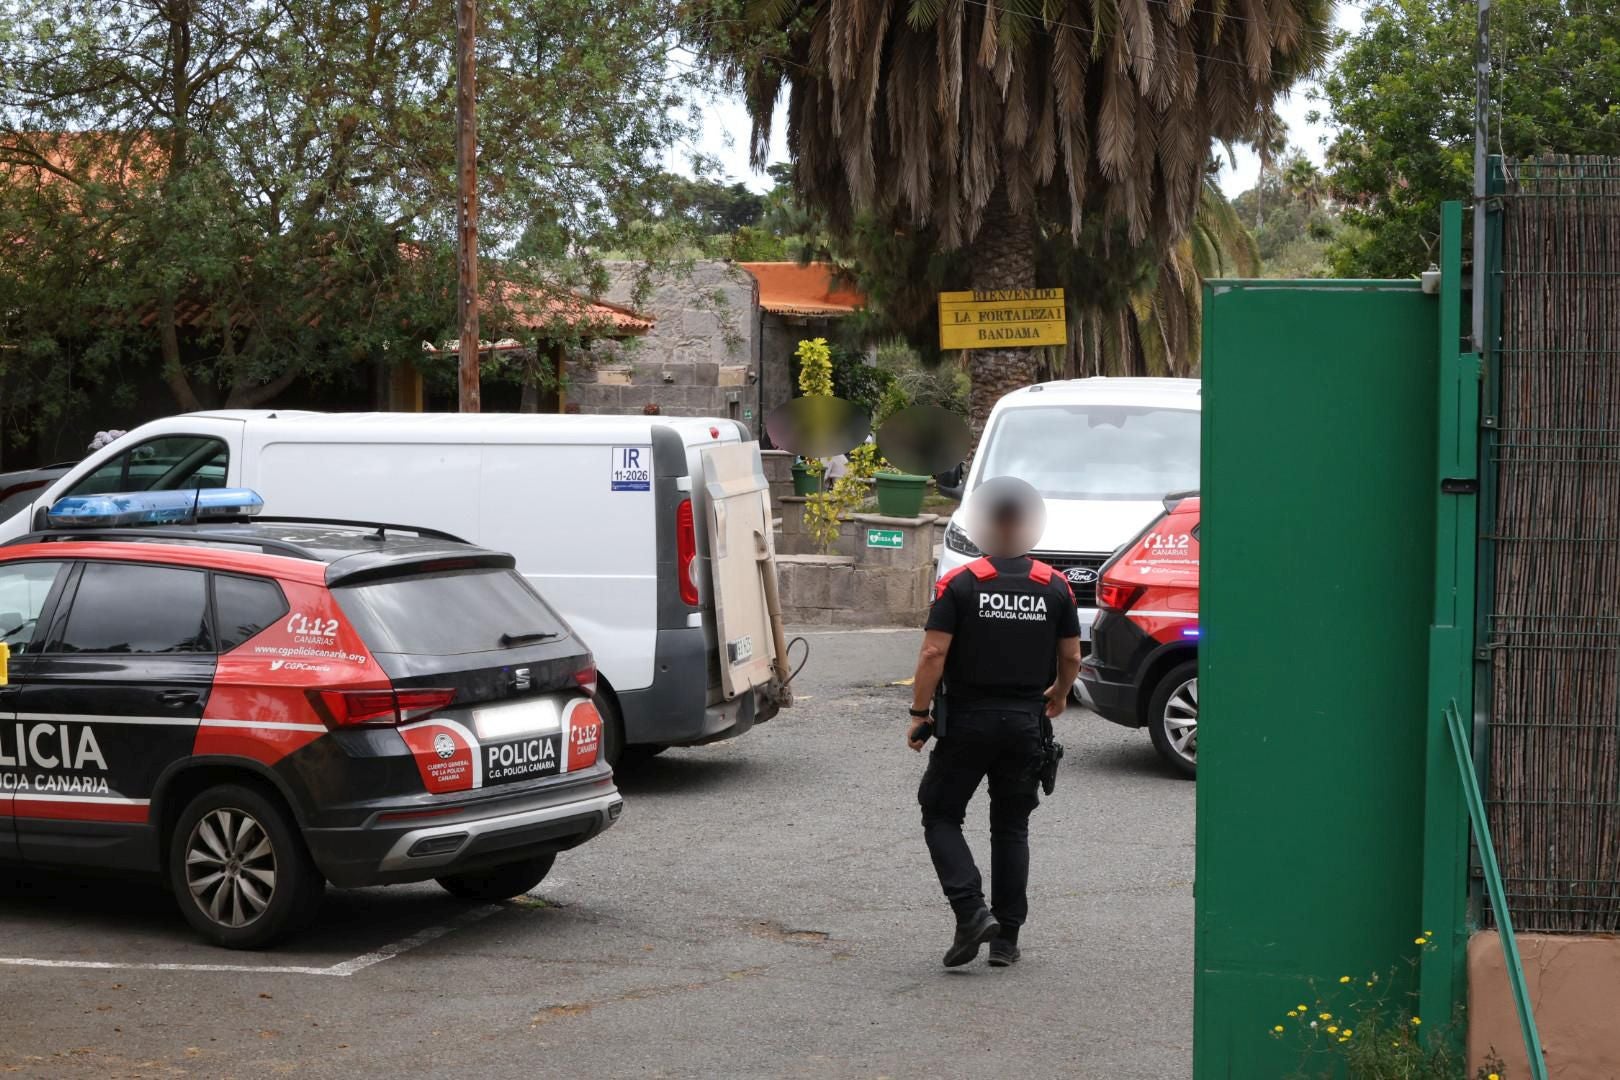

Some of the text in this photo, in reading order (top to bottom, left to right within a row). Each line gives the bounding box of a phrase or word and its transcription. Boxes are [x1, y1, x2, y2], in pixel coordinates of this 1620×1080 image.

[954, 311, 971, 323] LA
[978, 327, 1040, 340] BANDAMA
[623, 448, 640, 469] IR
[614, 470, 648, 481] 11-2026
[1067, 569, 1093, 581] Ford
[979, 592, 1047, 613] POLICIA
[1018, 612, 1047, 621] CANARIA
[294, 635, 334, 646] CANARIAS
[254, 645, 366, 664] www.cgpoliciacanaria.org
[488, 737, 556, 769] POLICIA
[489, 760, 556, 779] C.G. POLICIA CANARIA
[34, 774, 109, 793] CANARIA
